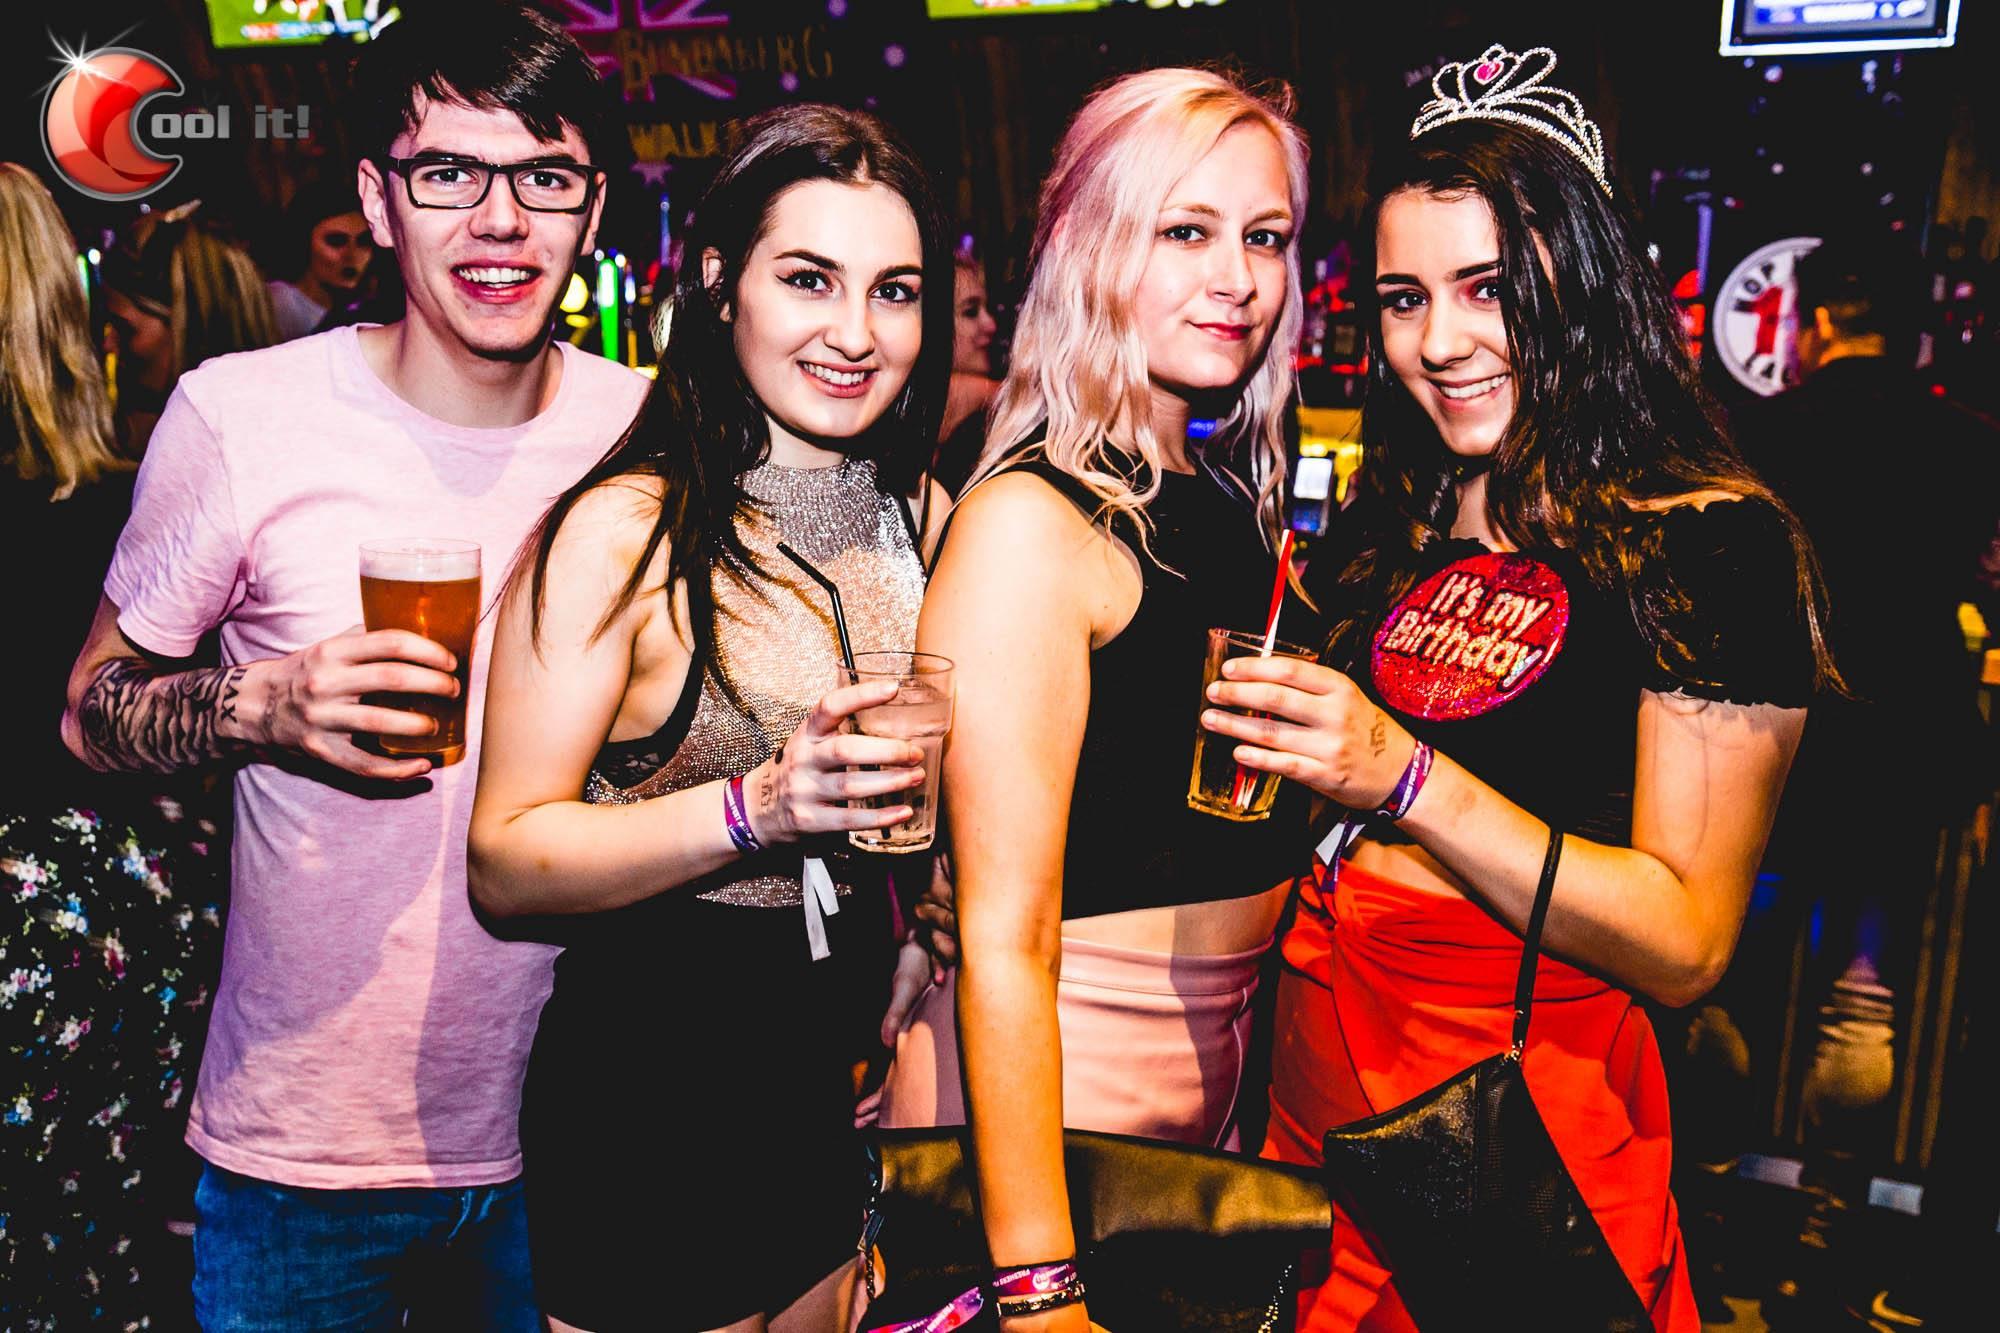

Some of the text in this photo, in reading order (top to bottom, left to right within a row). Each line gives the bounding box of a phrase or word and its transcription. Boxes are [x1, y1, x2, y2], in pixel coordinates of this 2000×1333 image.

[1430, 573, 1551, 639] It's my
[1384, 610, 1543, 688] Birthday
